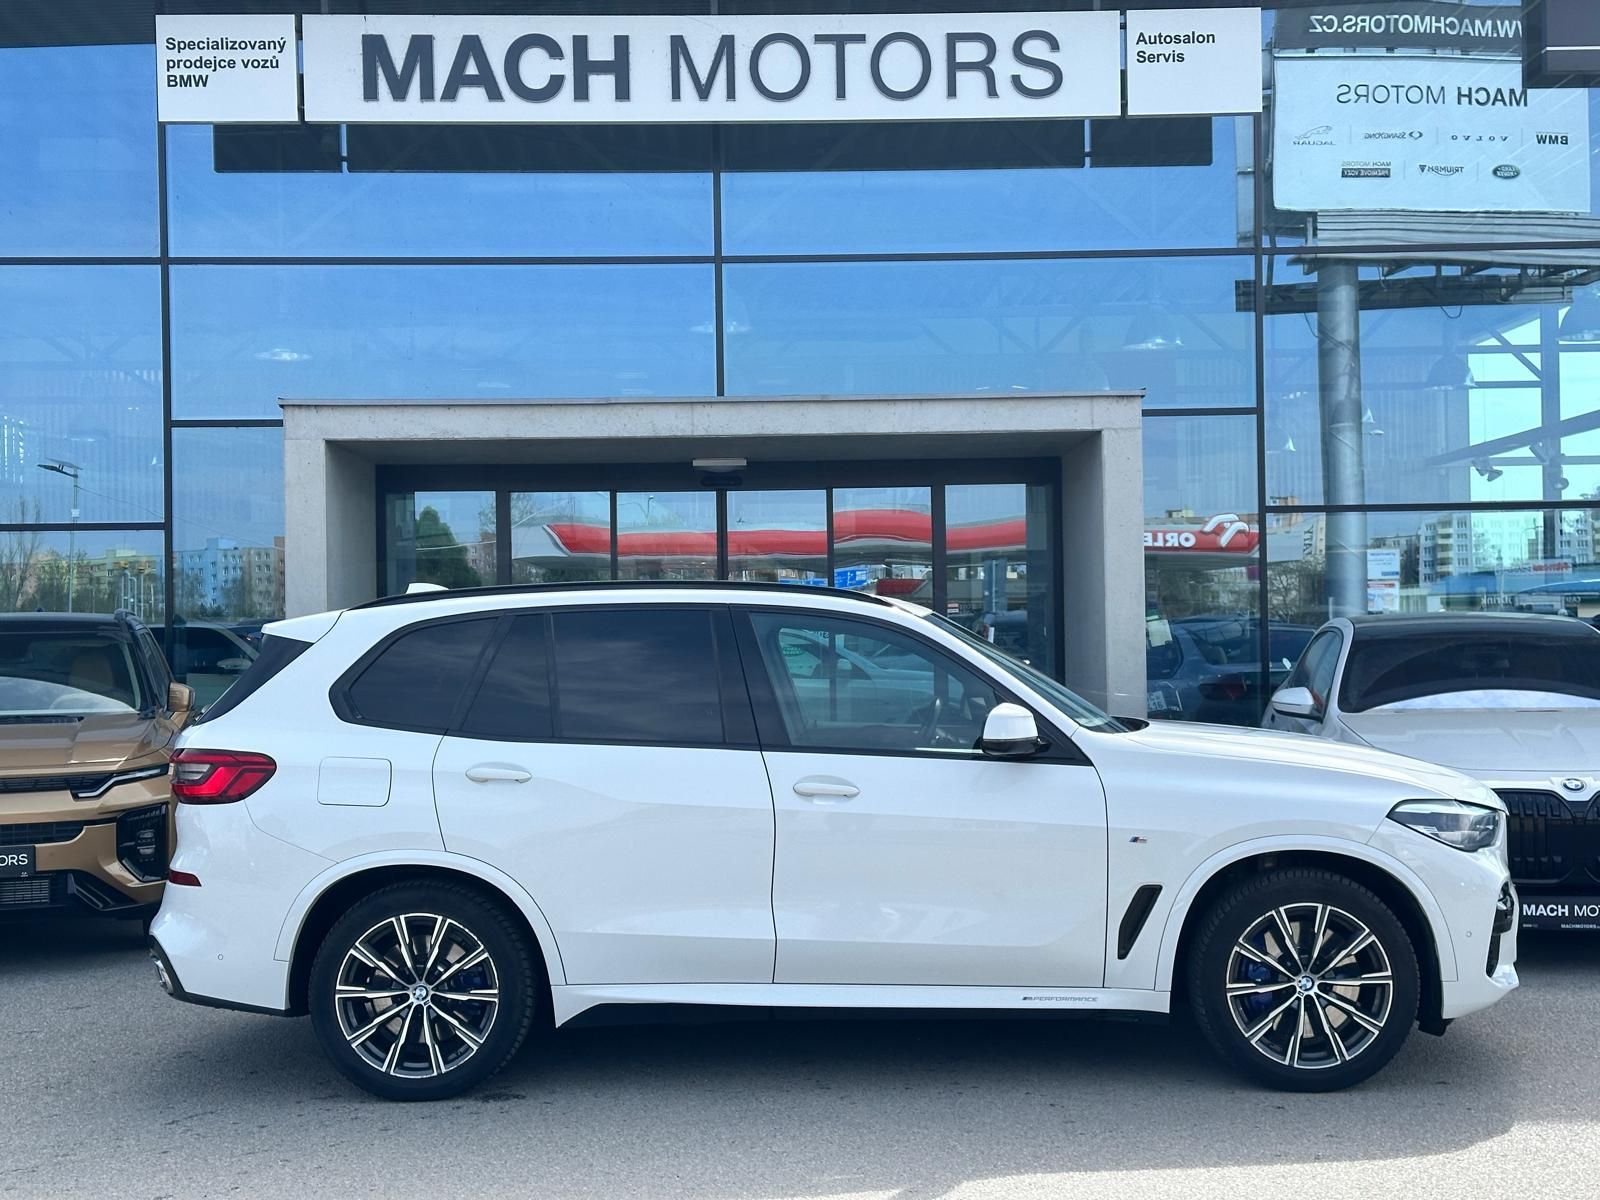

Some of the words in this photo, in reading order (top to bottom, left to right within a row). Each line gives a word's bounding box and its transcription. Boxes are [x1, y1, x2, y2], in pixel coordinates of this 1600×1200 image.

[165, 37, 287, 54] Specializovaný
[1136, 31, 1216, 46] Autosalon
[166, 56, 236, 72] prodejce
[241, 56, 280, 69] vozů
[1136, 50, 1185, 64] Servis
[362, 33, 631, 103] MACH
[672, 30, 1064, 101] MOTORS
[166, 74, 209, 88] BMW
[1522, 904, 1569, 917] MACH
[1574, 904, 1600, 917] MO
